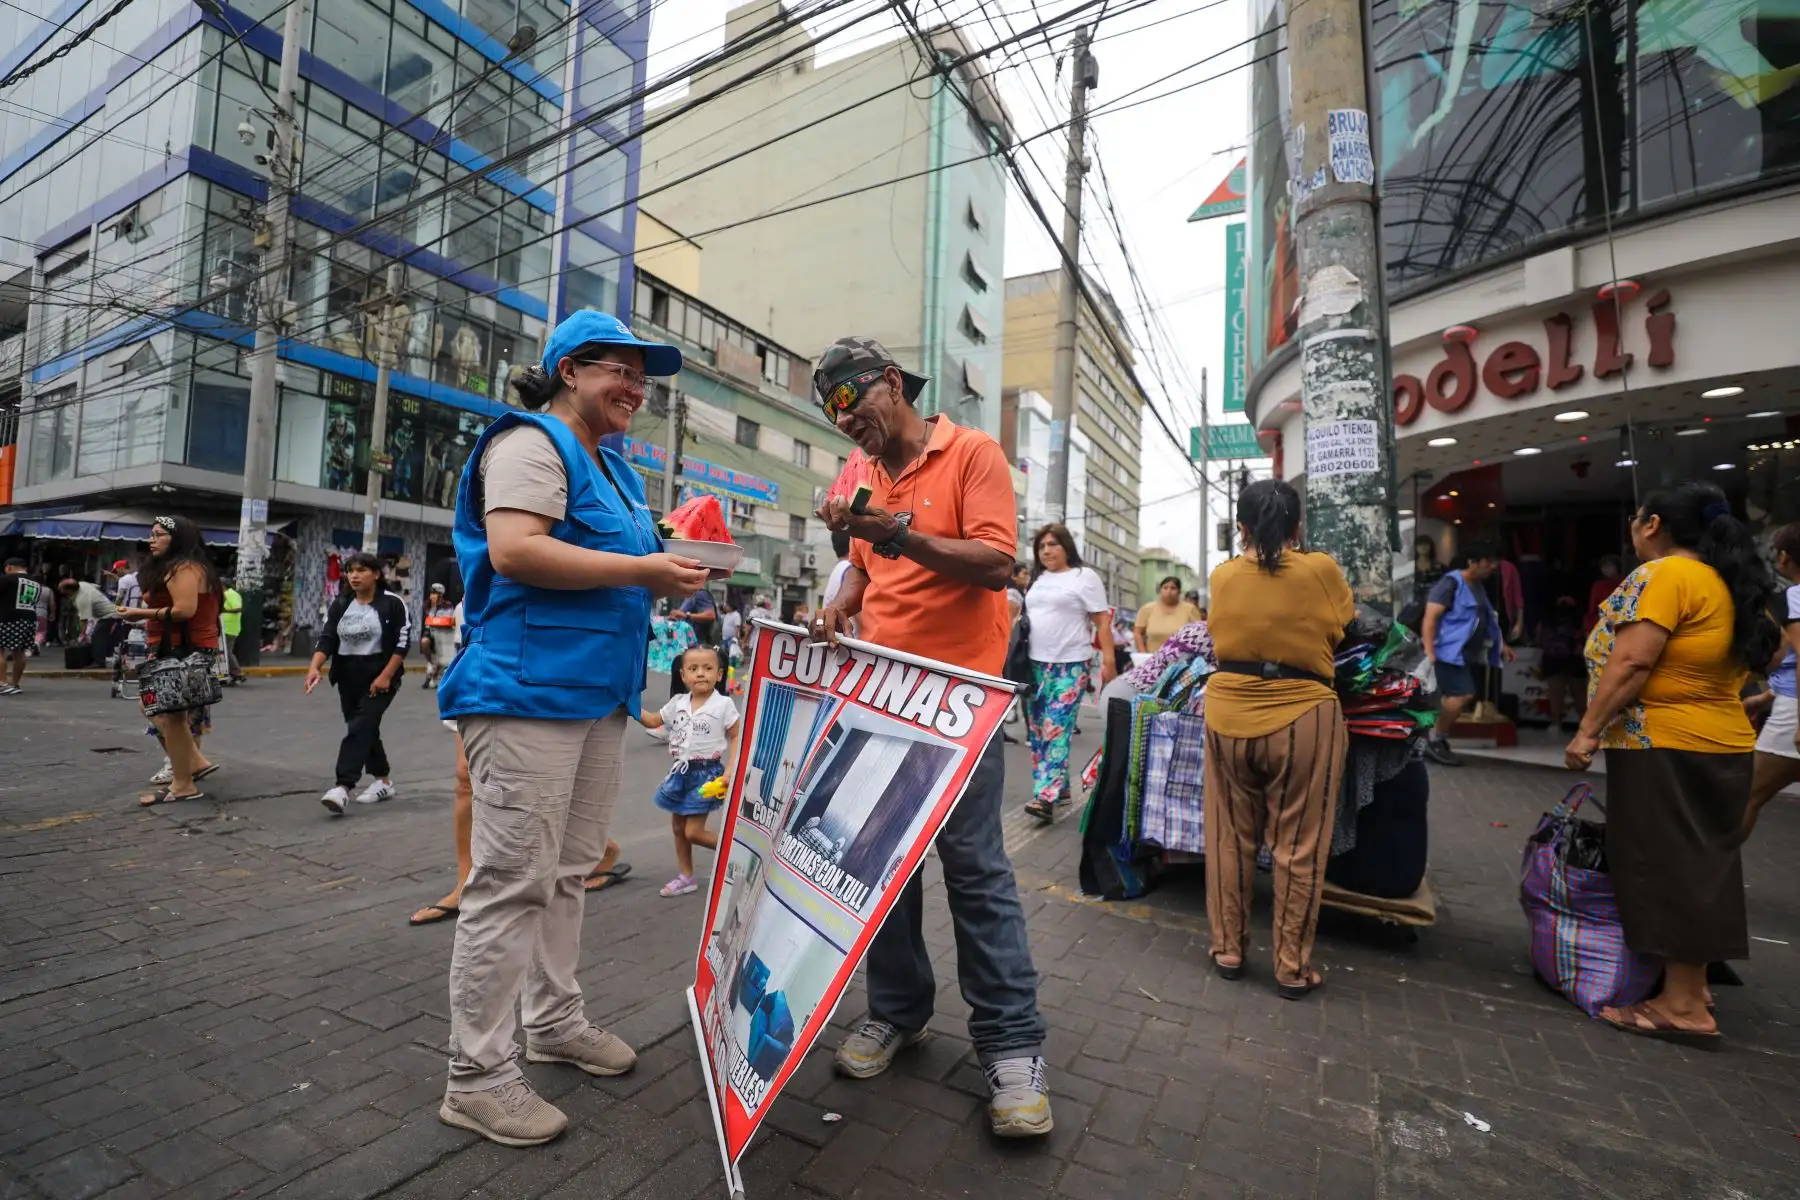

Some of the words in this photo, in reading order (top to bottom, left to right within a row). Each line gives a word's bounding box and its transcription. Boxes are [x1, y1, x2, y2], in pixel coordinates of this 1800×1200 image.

[1342, 423, 1373, 435] TIENDA
[1317, 447, 1356, 462] GAMARRA
[767, 632, 987, 739] CORTINAS
[778, 831, 822, 878] CORTINAS
[814, 859, 845, 894] CON
